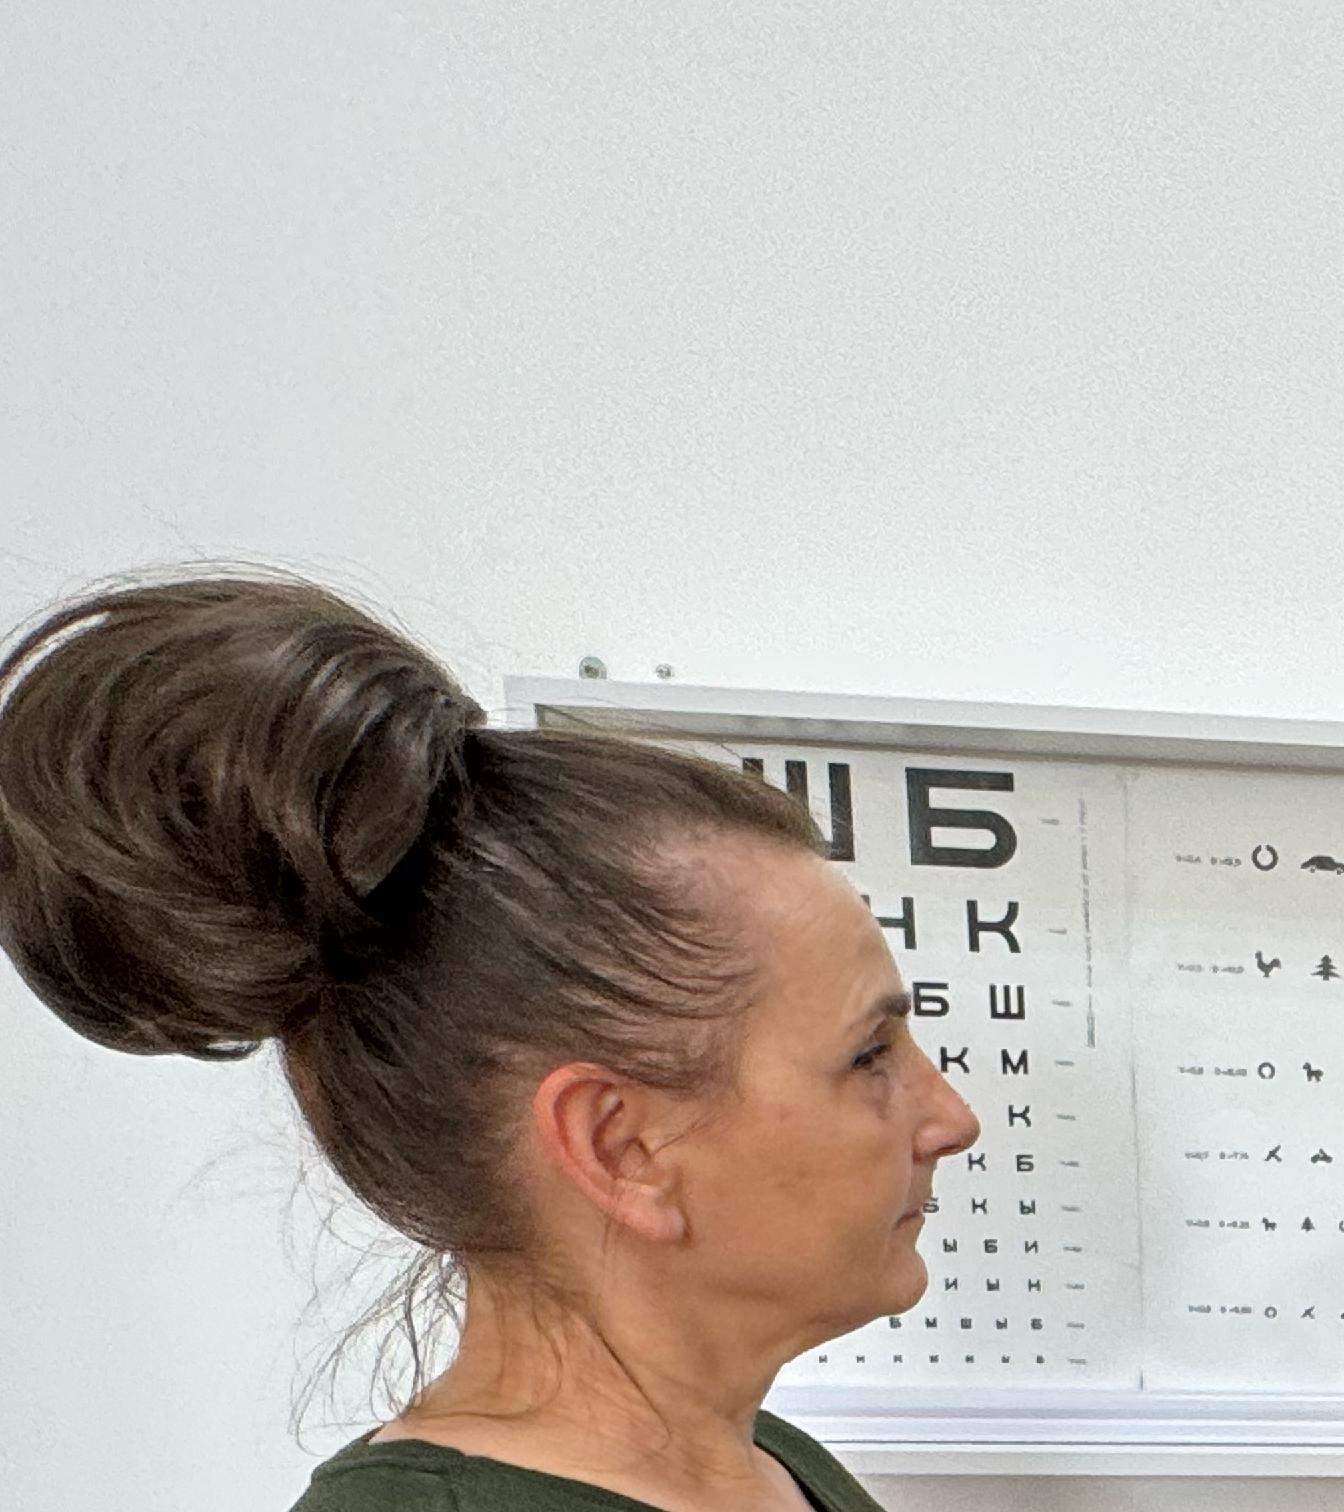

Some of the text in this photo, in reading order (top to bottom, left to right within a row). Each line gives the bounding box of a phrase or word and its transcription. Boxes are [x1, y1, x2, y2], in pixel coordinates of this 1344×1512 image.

[905, 767, 1017, 869] Б
[966, 899, 1021, 954] К
[912, 982, 1026, 1020] Б Ш
[940, 1047, 1029, 1075] К М
[1008, 1104, 1032, 1128] К
[967, 1152, 1035, 1172] К Б
[971, 1198, 988, 1215] К
[1019, 1200, 1036, 1216] Ы
[1024, 1240, 1039, 1254] И
[944, 1277, 958, 1291] И
[1027, 1278, 1042, 1293] Н
